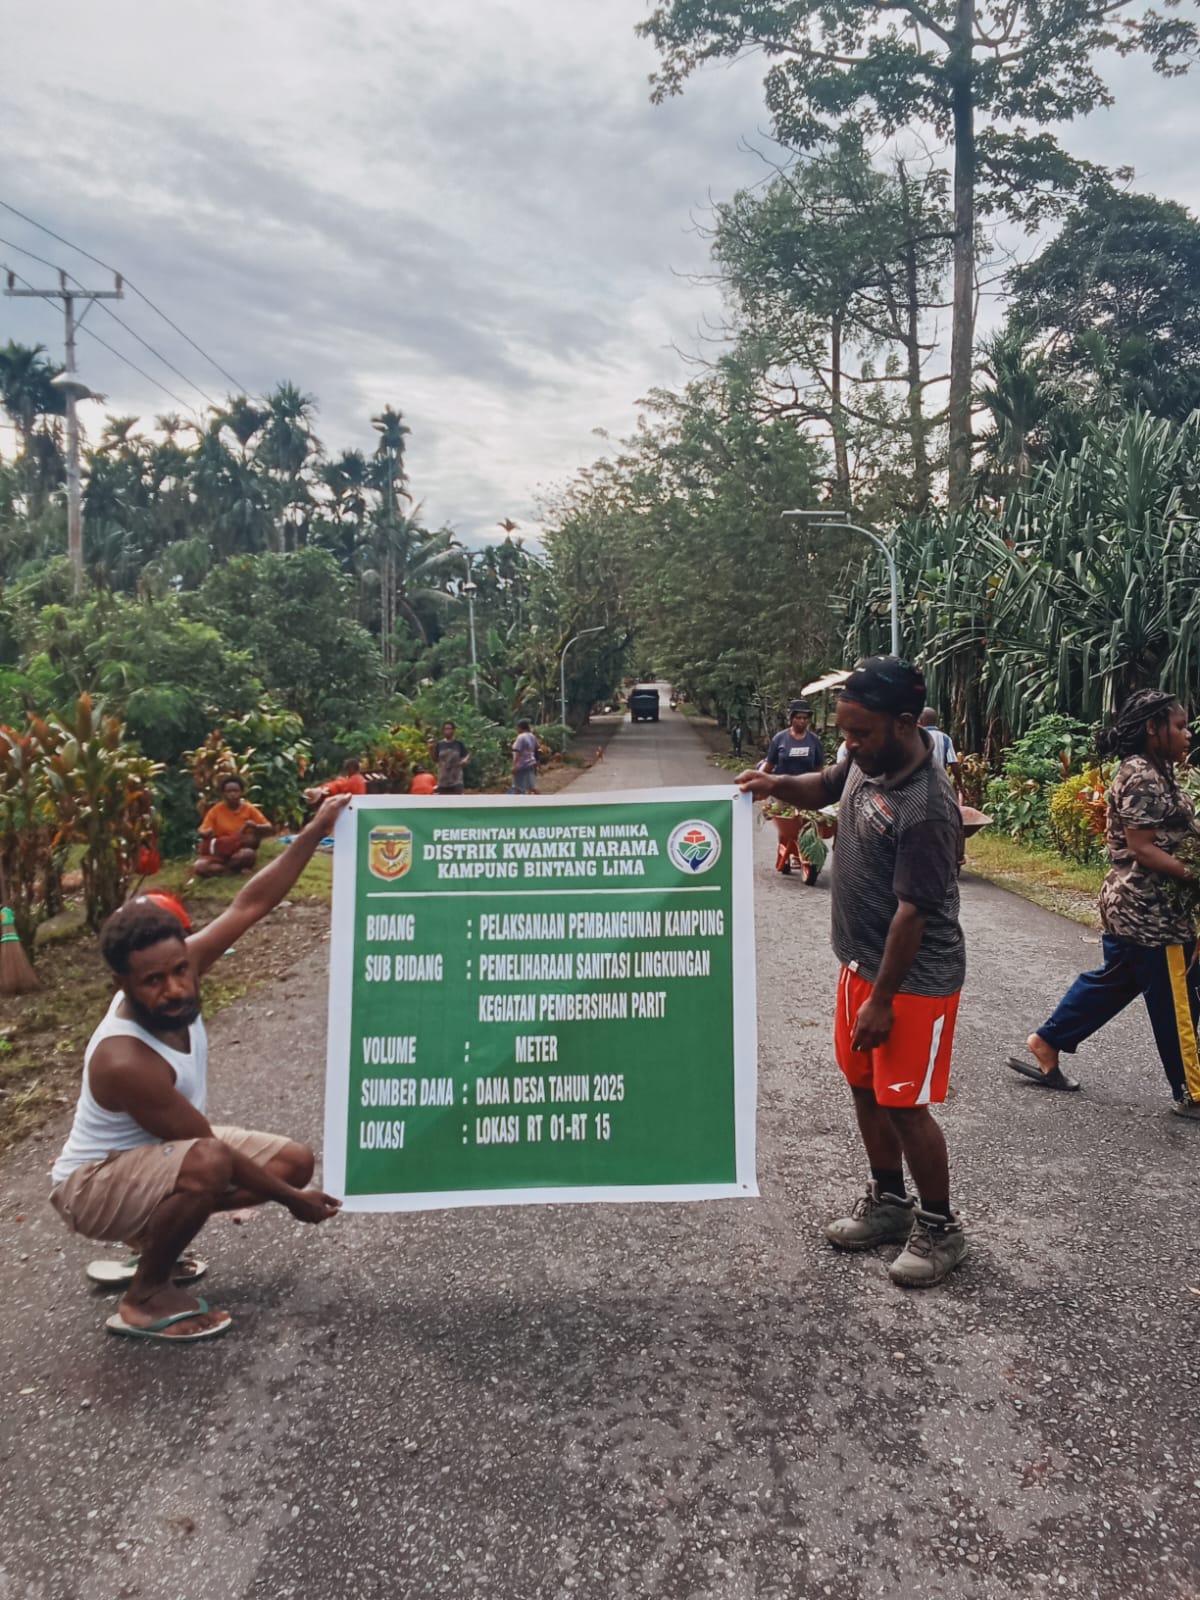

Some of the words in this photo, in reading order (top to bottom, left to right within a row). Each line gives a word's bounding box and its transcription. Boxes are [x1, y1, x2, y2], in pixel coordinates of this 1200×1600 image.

[433, 828, 516, 841] PEMERINTAH
[519, 825, 596, 839] KABUPATEN
[600, 824, 649, 838] MIMIKA
[423, 843, 497, 861] DISTRIK
[503, 842, 576, 859] KWAMKI
[582, 839, 659, 857] NARAMA
[438, 862, 518, 879] KAMPUNG
[524, 861, 596, 877] BINTANG
[603, 859, 645, 876] LIMA
[366, 914, 415, 942] BIDANG
[480, 911, 565, 940] PELAKSANAAN
[569, 910, 662, 939] PEMBANGUNAN
[664, 908, 724, 937] KAMPUNG
[365, 954, 392, 982] SUB
[395, 953, 443, 982] BIDANG
[479, 953, 573, 981] PEMELIHARAAN
[576, 951, 631, 979] SANITASI
[634, 949, 711, 978] LINGKUNGAN
[479, 993, 536, 1022] KEGIATAN
[539, 991, 628, 1021] PEMBERSIHAN
[631, 990, 667, 1018] PARIT
[363, 1036, 417, 1065] VOLUME
[515, 1034, 558, 1064] METER
[361, 1077, 417, 1107] SUMBER
[419, 1076, 454, 1106] DANA
[476, 1076, 510, 1106] DANA
[513, 1076, 546, 1104] DESA
[549, 1074, 590, 1103] TAHUN
[594, 1073, 624, 1101] 2025
[360, 1120, 405, 1150] LOKASI
[476, 1115, 520, 1145] LOKASI
[527, 1115, 543, 1143] RT
[595, 1113, 611, 1141] 15
